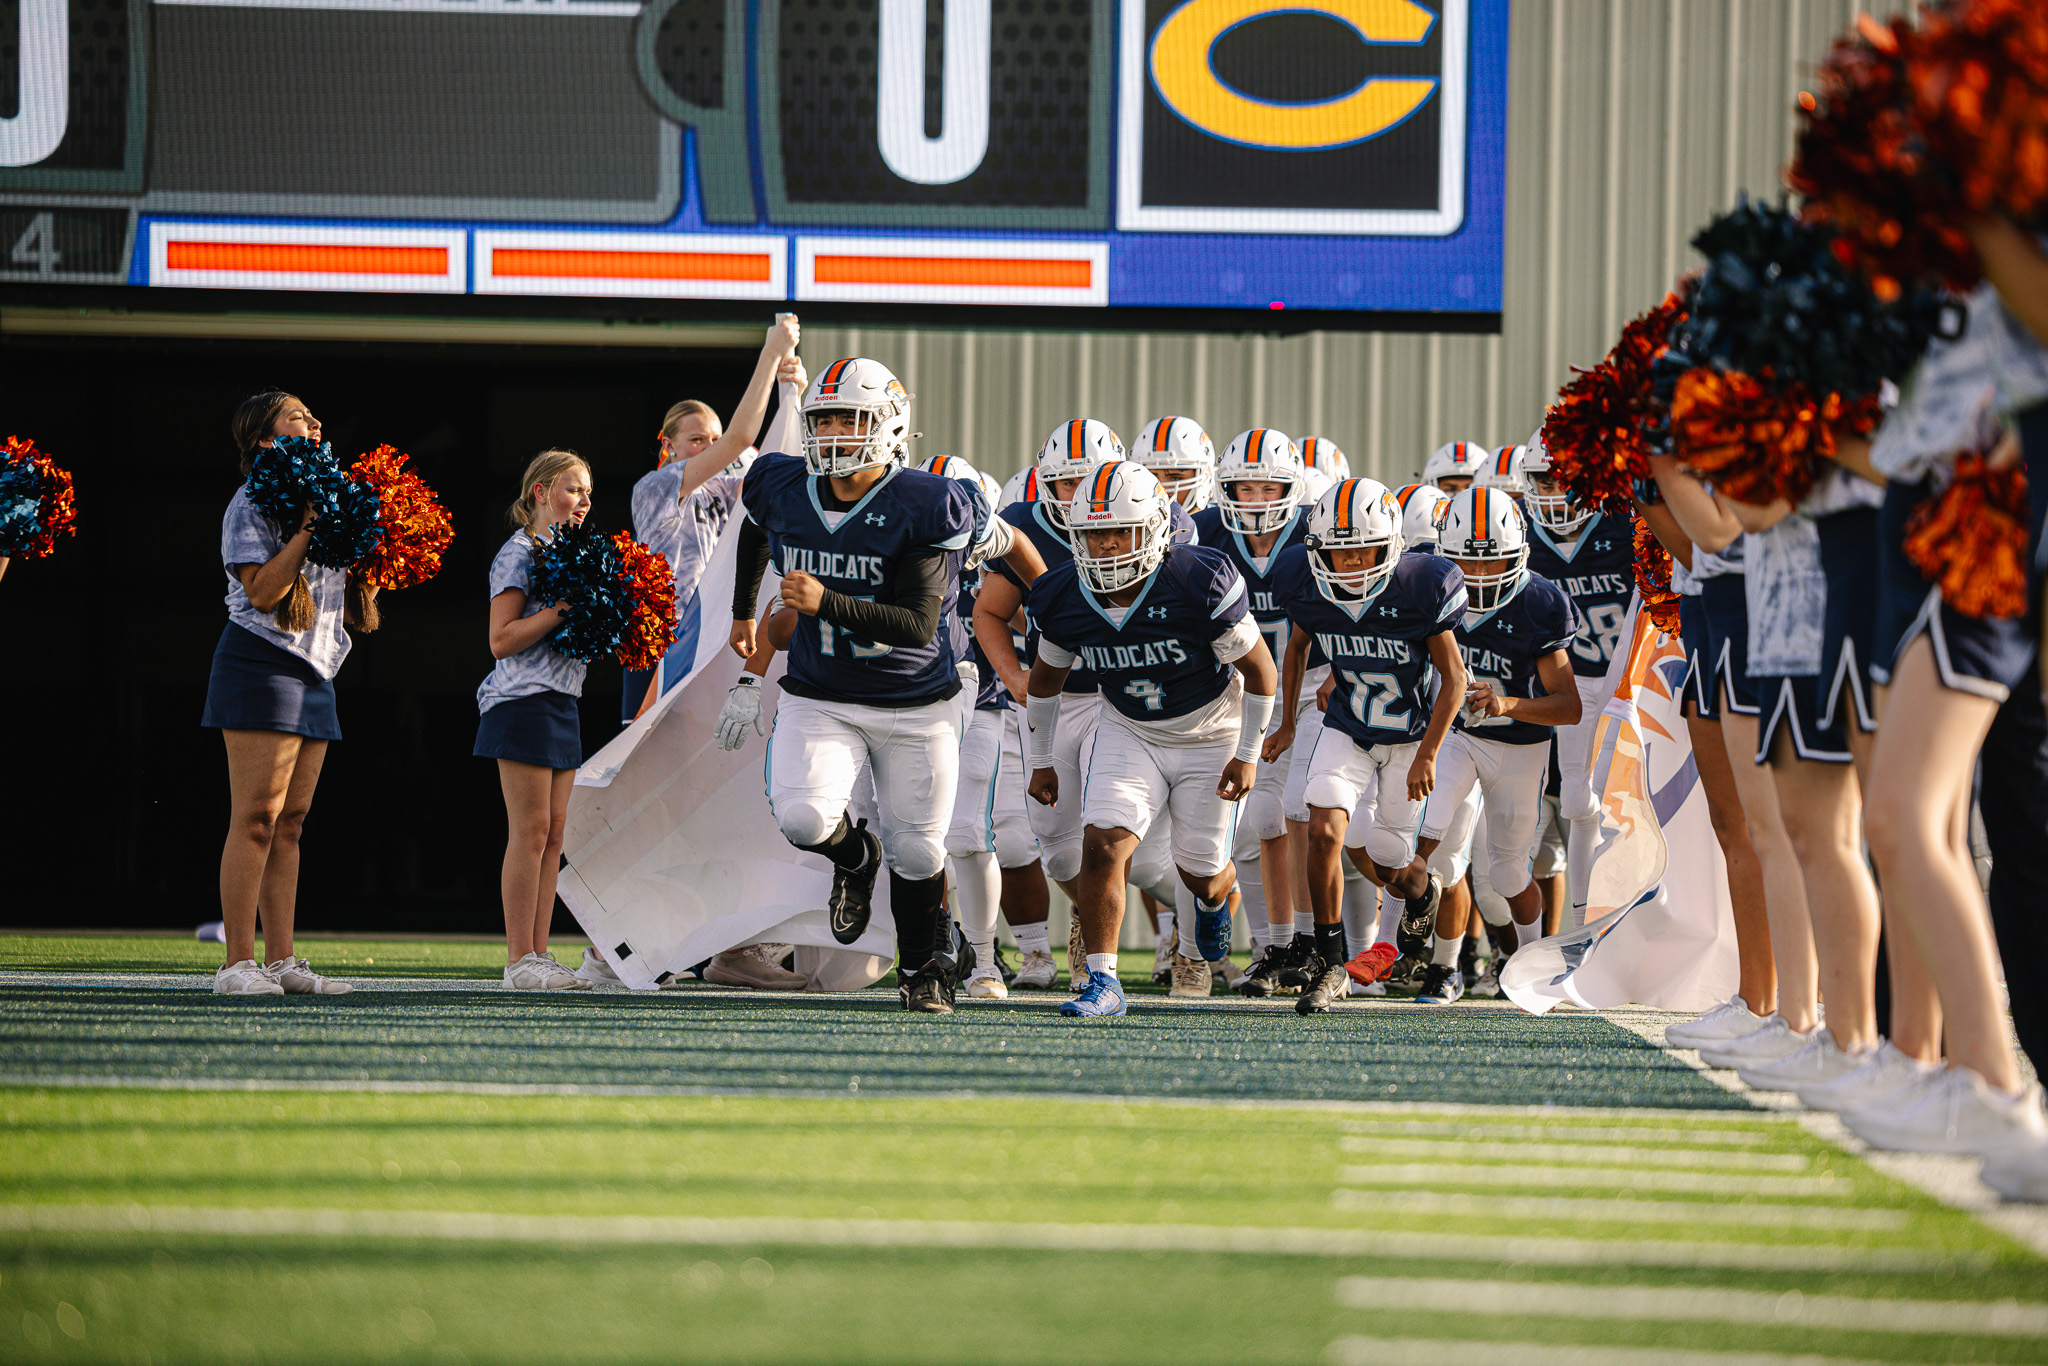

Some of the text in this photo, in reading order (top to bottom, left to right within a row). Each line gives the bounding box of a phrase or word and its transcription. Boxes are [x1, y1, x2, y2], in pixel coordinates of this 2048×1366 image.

[1149, 0, 1441, 151] C
[12, 212, 61, 279] 4
[1087, 512, 1112, 521] Riddell
[782, 544, 885, 587] WILDCATS
[1080, 638, 1188, 672] WILDCATS
[1314, 632, 1411, 666] WILDCATS
[1458, 642, 1513, 681] DCATS
[1341, 669, 1412, 732] 12
